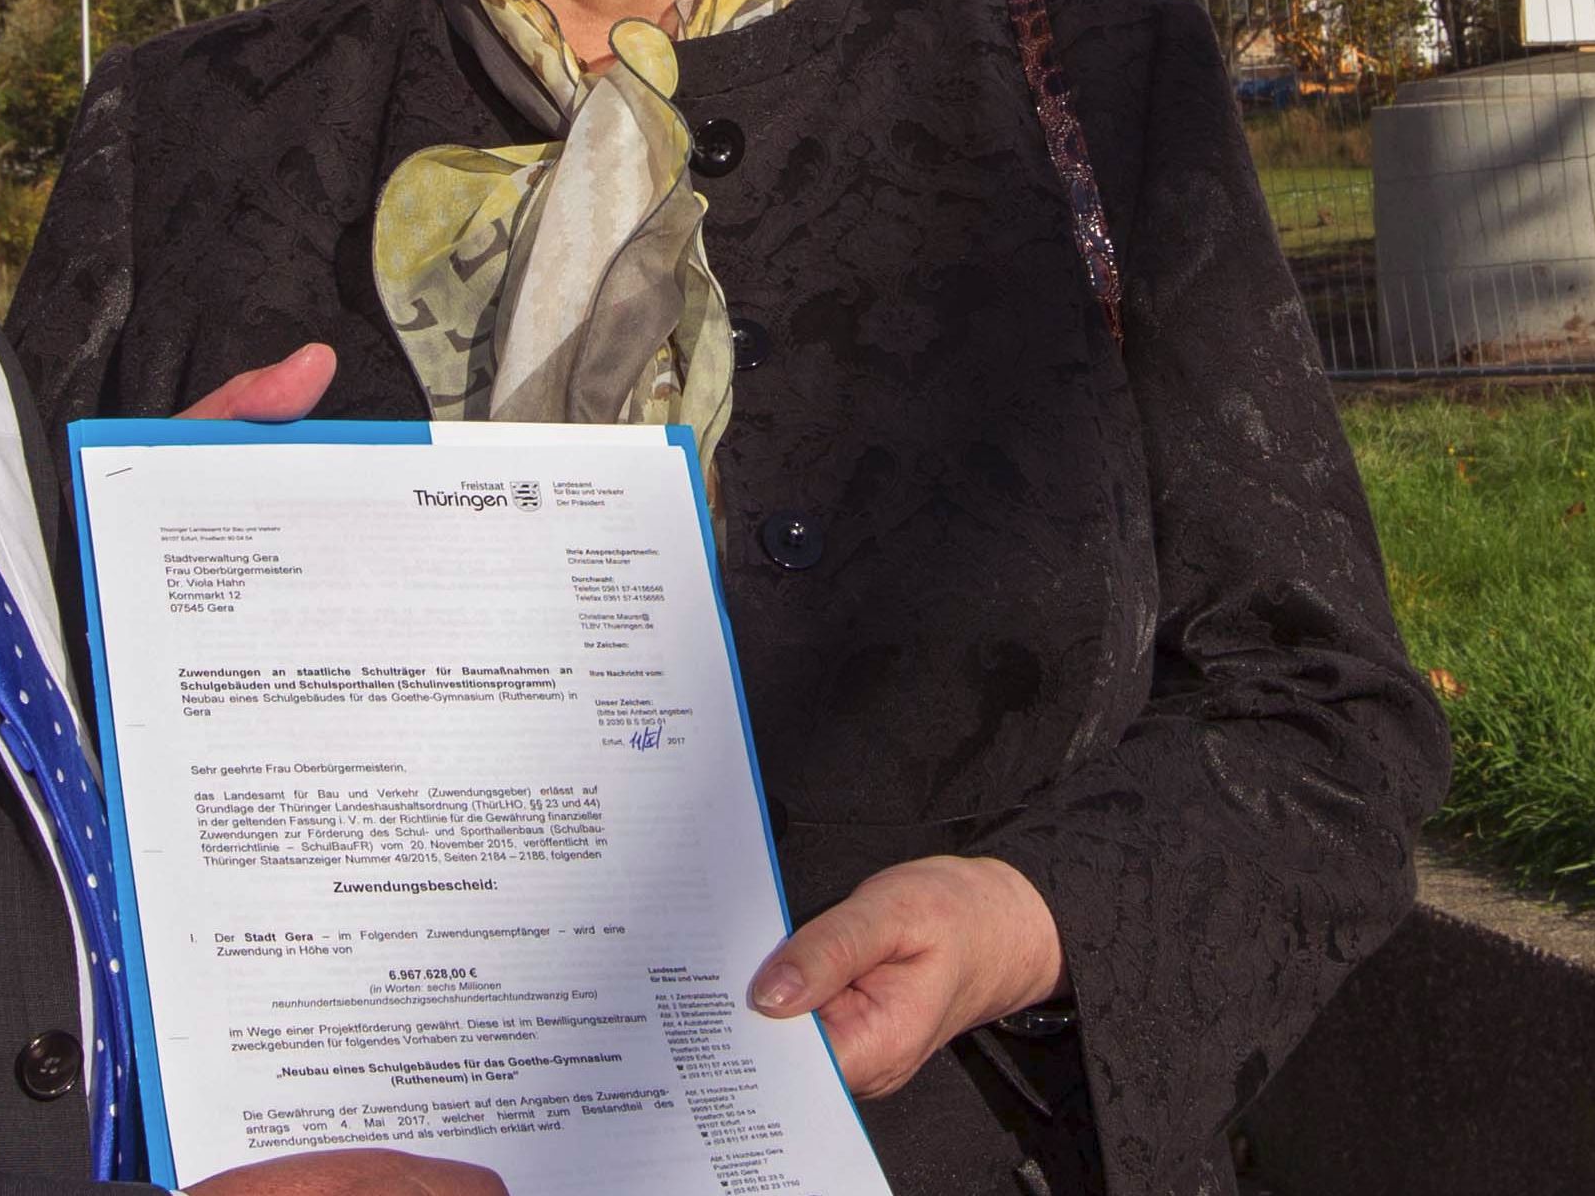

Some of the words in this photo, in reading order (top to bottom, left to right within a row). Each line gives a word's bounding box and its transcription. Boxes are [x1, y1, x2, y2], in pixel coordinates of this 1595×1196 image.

[460, 481, 505, 491] Freistaat
[552, 481, 593, 491] Landesamt
[413, 490, 508, 511] Thüringen
[556, 499, 570, 507] Der
[163, 554, 250, 564] Stadtverwaltung
[252, 553, 280, 563] Gera
[165, 566, 191, 575] Frau
[193, 566, 303, 576] Oberbürgermeisterin
[166, 578, 183, 588] Dr.
[186, 578, 214, 588] Viola
[216, 578, 246, 587] Hahn
[168, 591, 225, 600] Kornmarkt
[228, 590, 241, 600] 12
[170, 603, 205, 613] 07545
[206, 603, 235, 613] Gera
[178, 668, 261, 679] Zuwendungen
[271, 669, 286, 677] an
[296, 667, 351, 677] staatliche
[361, 667, 426, 678] Schulträger
[436, 666, 452, 676] für
[461, 666, 550, 676] Baumaßnahmen
[559, 667, 573, 675] an
[180, 681, 271, 693] Schulgebäuden
[273, 680, 297, 690] und
[298, 680, 395, 690] Schulsporthallen
[397, 679, 556, 690] (Schulinvestitionsprogramm)
[181, 691, 225, 704] Neubau
[229, 694, 259, 703] eines
[262, 693, 346, 704] Schulgebäudes
[349, 692, 363, 702] für
[367, 693, 388, 702] das
[391, 692, 495, 703] Goethe-Gymnasium
[498, 691, 565, 702] (Rutheneum)
[568, 692, 578, 700] in
[182, 706, 211, 717] Gera
[190, 765, 218, 775] Sehr
[220, 765, 263, 777] geehrte
[265, 763, 292, 774] Frau
[193, 791, 215, 801] das
[223, 791, 286, 801] Landesamt
[293, 789, 309, 800] für
[317, 789, 340, 799] Bau
[348, 789, 369, 799] und
[376, 788, 419, 798] Verkehr
[427, 787, 532, 799] (Zuwendungsgeber)
[539, 786, 574, 796] erlässt
[582, 785, 598, 795] auf
[195, 804, 255, 816] Grundlage
[257, 803, 276, 813] der
[278, 802, 332, 815] Thüringer
[334, 801, 469, 812] Landeshaushaltsordnung
[544, 798, 559, 813] 23
[561, 798, 582, 808] und
[583, 798, 601, 810] 44)
[333, 879, 498, 894] Zuwendungsbescheid:
[214, 932, 235, 943] Der
[244, 932, 277, 943] Stadt
[284, 931, 314, 942] Gera
[338, 932, 352, 941] im
[359, 930, 418, 942] Folgenden
[426, 927, 550, 939] Zuwendungsempfänger
[573, 925, 596, 935] wird
[603, 926, 626, 934] eine
[216, 946, 283, 958] Zuwendung
[285, 945, 297, 955] in
[298, 945, 329, 955] Höhe
[332, 946, 353, 955] von
[388, 968, 467, 980] 6.967.628,00
[469, 967, 478, 979] €
[369, 984, 382, 995] (in
[427, 983, 457, 992] sechs
[458, 981, 502, 991] Millionen
[571, 989, 598, 1000] Euro)
[332, 1065, 366, 1075] eines
[368, 1061, 461, 1074] Schulgebäudes
[463, 1059, 481, 1069] für
[483, 1058, 505, 1068] das
[507, 1054, 622, 1067] Goethe-Gymnasium
[391, 1073, 469, 1087] (Rutheneum)
[471, 1072, 483, 1082] in
